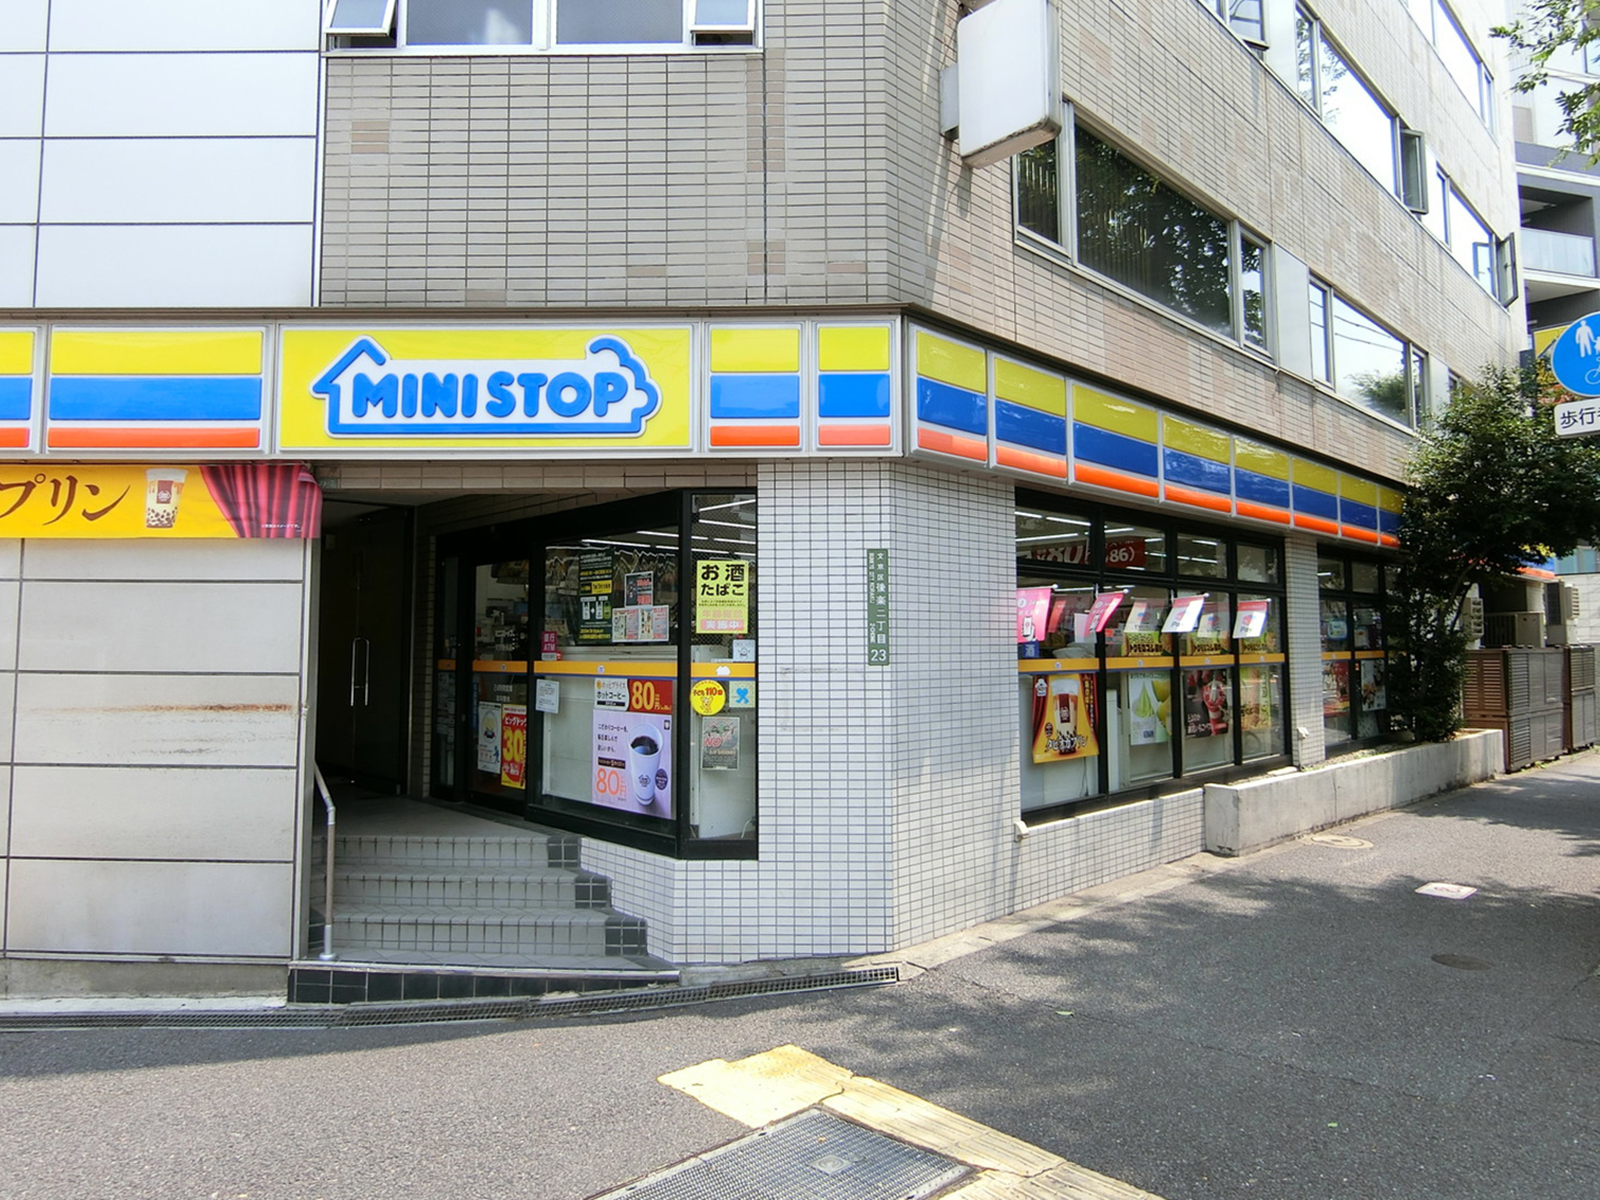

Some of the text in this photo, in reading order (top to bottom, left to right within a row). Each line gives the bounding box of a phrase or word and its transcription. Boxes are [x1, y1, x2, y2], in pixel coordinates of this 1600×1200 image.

[1560, 406, 1600, 429] 歩行
[0, 473, 131, 526] プリン
[701, 564, 745, 581] お酒
[701, 583, 744, 596] たばこ
[543, 643, 555, 651] ATM
[870, 649, 887, 661] 23
[596, 691, 626, 700] ホットコーヒー
